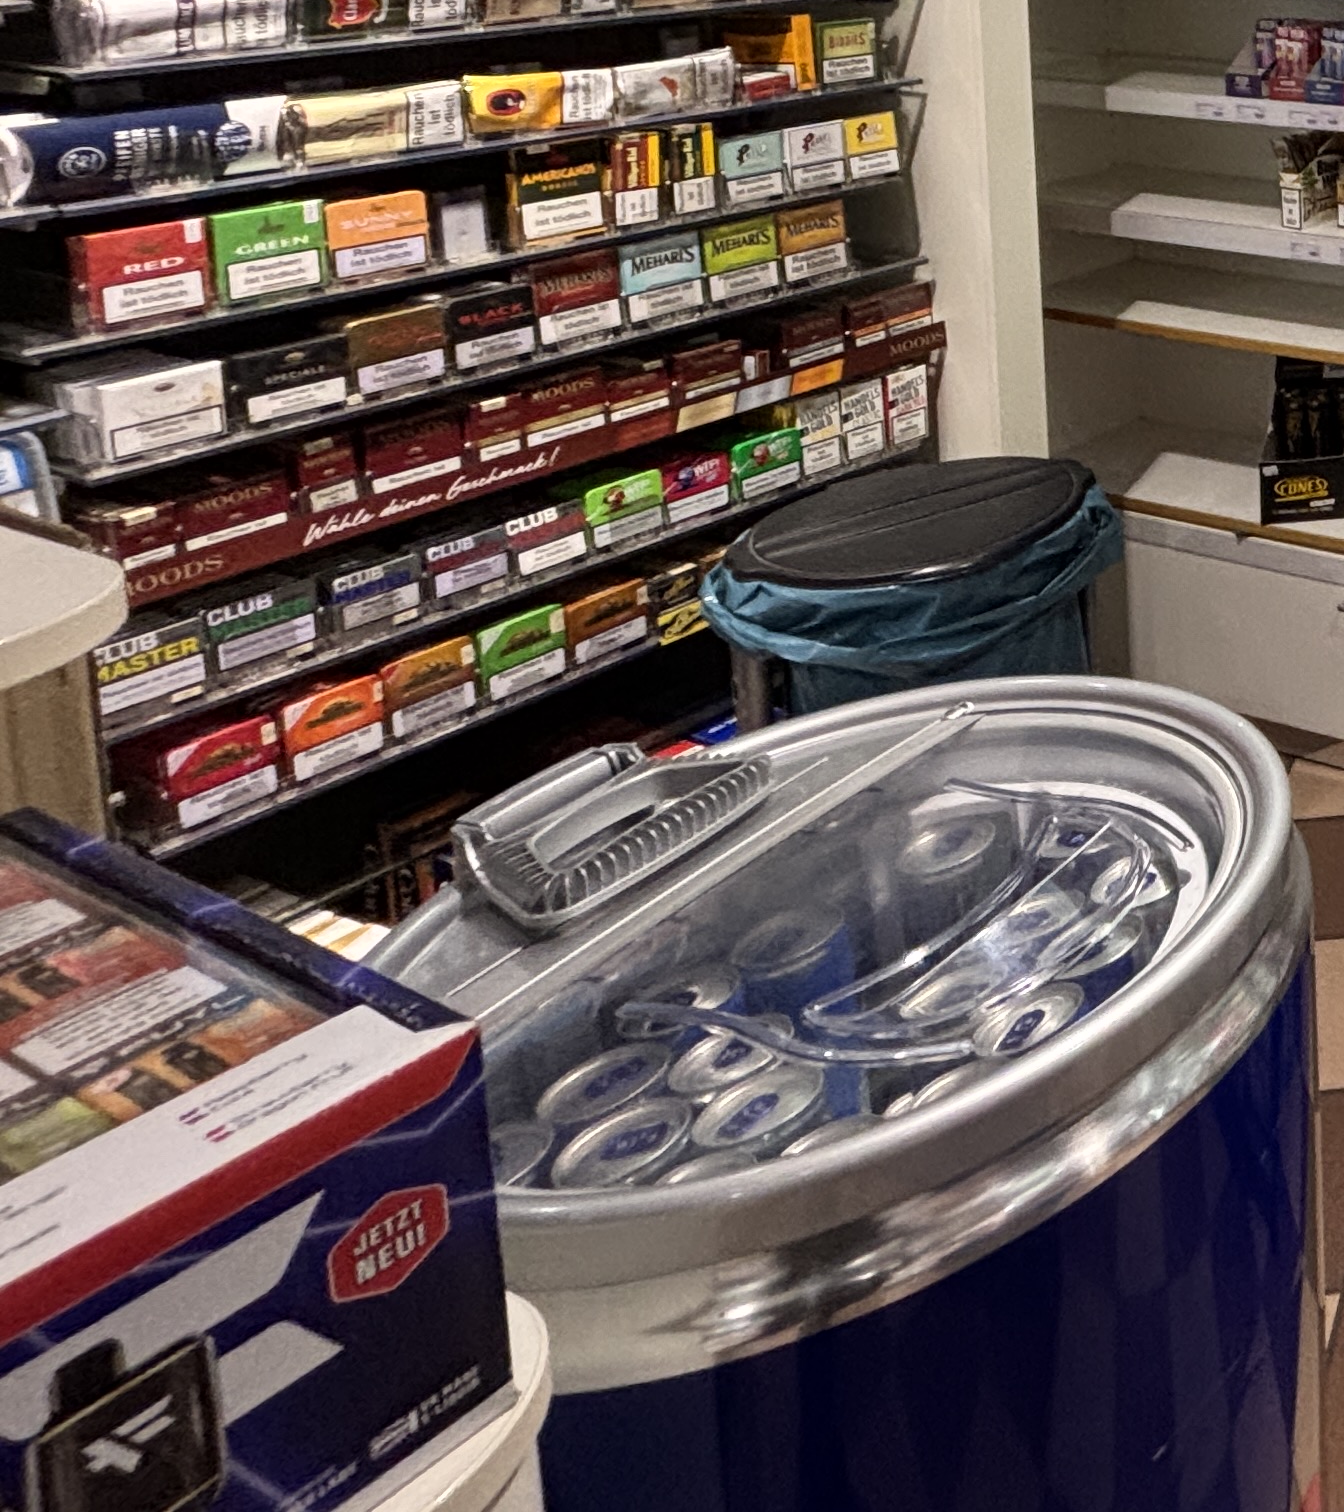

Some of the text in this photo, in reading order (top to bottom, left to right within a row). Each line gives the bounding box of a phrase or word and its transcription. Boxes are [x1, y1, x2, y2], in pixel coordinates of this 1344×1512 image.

[411, 93, 457, 146] Rauchen tödlich
[522, 163, 596, 186] AMERICANOS
[537, 196, 588, 213] Rauchen
[340, 210, 413, 231] SUNNY
[235, 235, 310, 256] GREEN
[123, 256, 185, 276] RED
[630, 247, 695, 277] MEHARI'S
[303, 446, 562, 547] Wähle deinen Geschmack!
[504, 507, 558, 536] CLUB
[427, 536, 476, 563] CLUB
[331, 565, 385, 594] CLUB
[206, 593, 274, 627] CLUB
[354, 1198, 423, 1257] JETZT
[355, 1224, 426, 1285] NEU!
